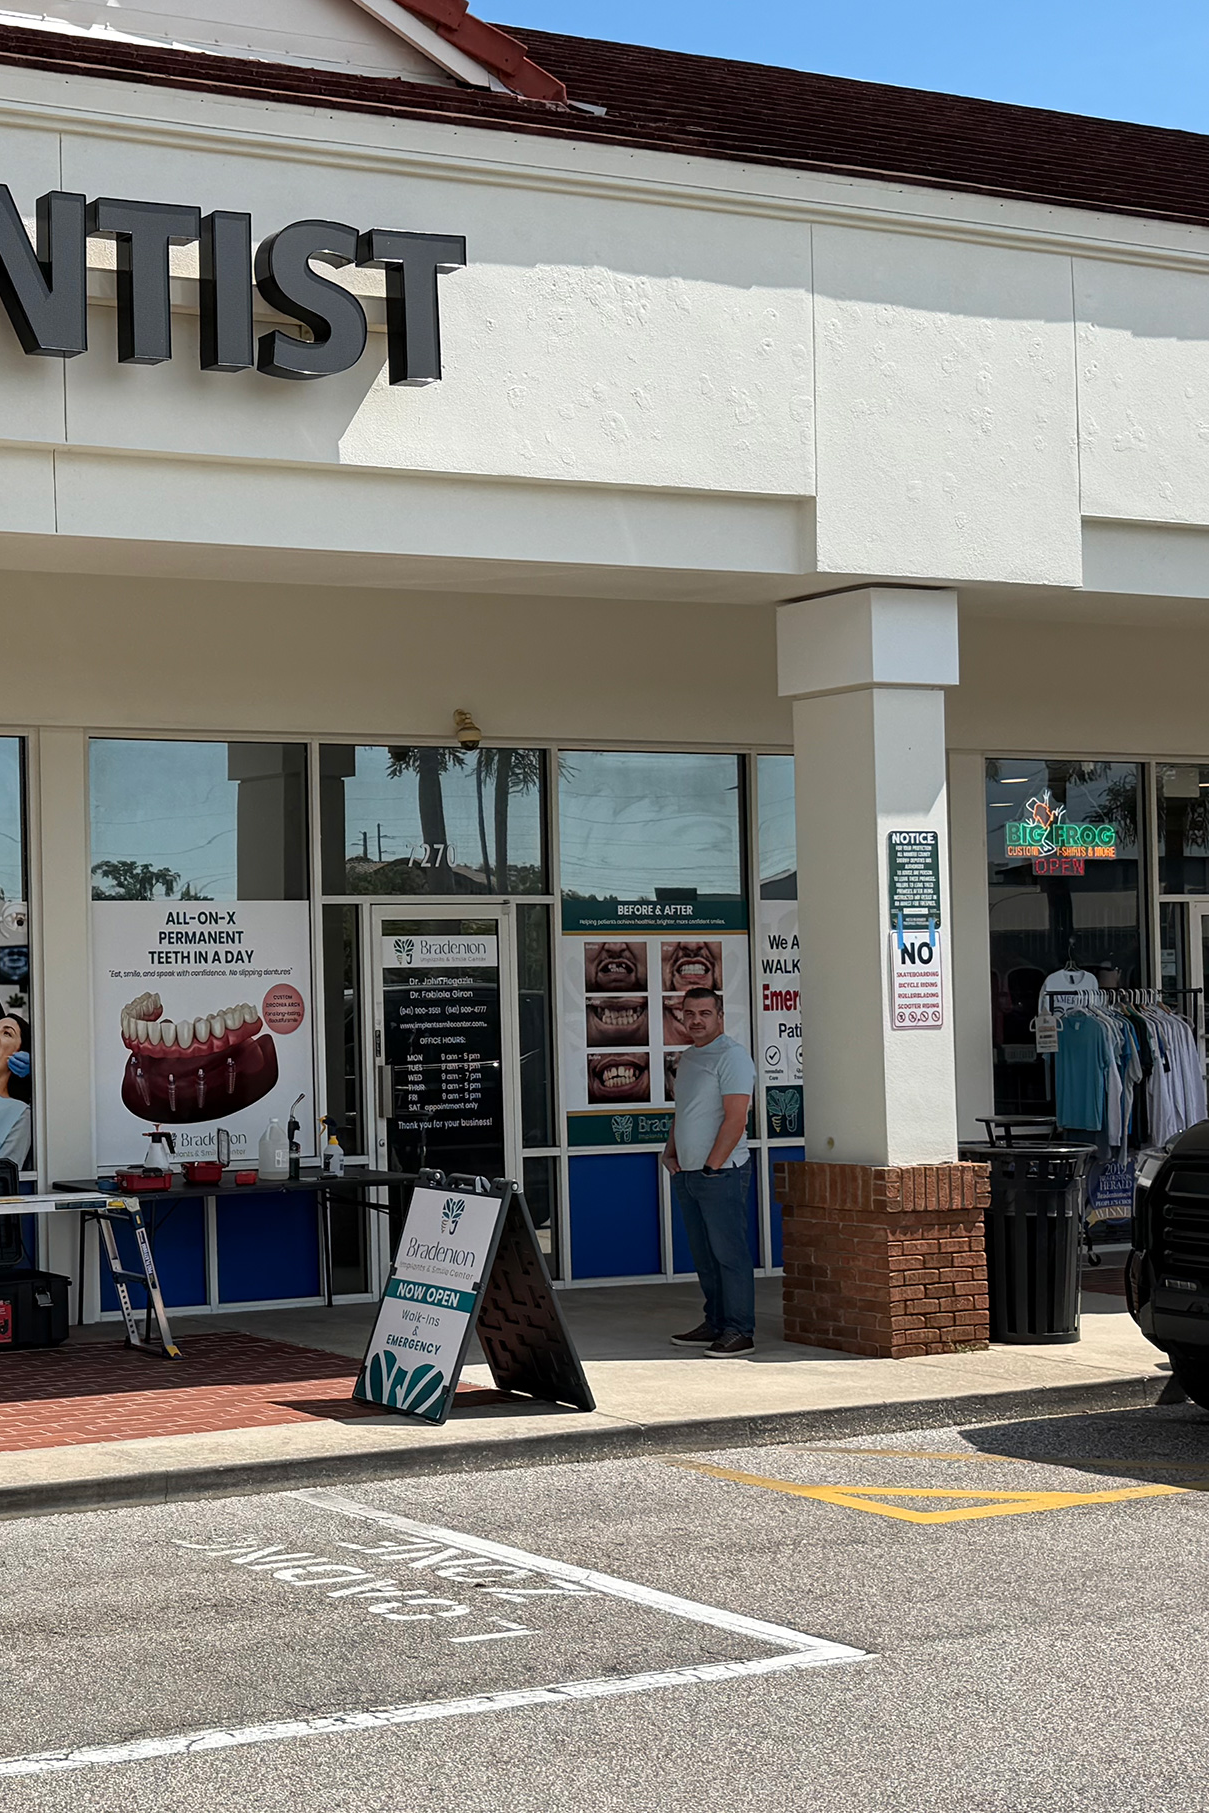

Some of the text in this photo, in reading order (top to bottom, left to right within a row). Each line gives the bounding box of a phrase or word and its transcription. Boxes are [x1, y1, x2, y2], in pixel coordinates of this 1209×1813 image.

[891, 833, 935, 844] NOTICE
[1006, 823, 1116, 847] BIG FROG
[406, 843, 457, 868] 7270
[1008, 846, 1116, 858] CUSTOM T-SHIRTS & MORE
[1035, 859, 1085, 875] OPEN
[617, 904, 693, 915] BEFORE & AFTER
[165, 911, 236, 925] ALL-ON-X
[158, 930, 244, 945] PERMANENT
[768, 934, 788, 950] We
[420, 940, 487, 955] Bradenton
[901, 942, 933, 965] NO
[148, 950, 254, 965] TEETH IN A DAY
[176, 969, 190, 977] with
[409, 977, 420, 985] Dr.
[410, 990, 473, 999] Dr. Fabiola Giron
[762, 984, 801, 1013] Emer
[778, 1023, 802, 1038] Pati
[442, 1036, 466, 1044] HOURS:
[468, 1053, 480, 1061] pm
[470, 1073, 481, 1081] pm
[469, 1083, 481, 1091] pm
[470, 1093, 481, 1101] pm
[424, 1102, 464, 1112] appointment
[465, 1102, 478, 1110] only
[398, 1117, 493, 1130] Thank you for your business!
[1105, 1163, 1127, 1175] 2019
[1100, 1180, 1132, 1190] HERALD
[406, 1237, 475, 1268] Bradenton
[397, 1282, 460, 1308] NOW OPEN
[401, 1308, 440, 1327] Walk-Ins
[412, 1325, 419, 1336] &
[386, 1334, 441, 1355] EMERGENCY
[336, 1537, 605, 1606] ZONE
